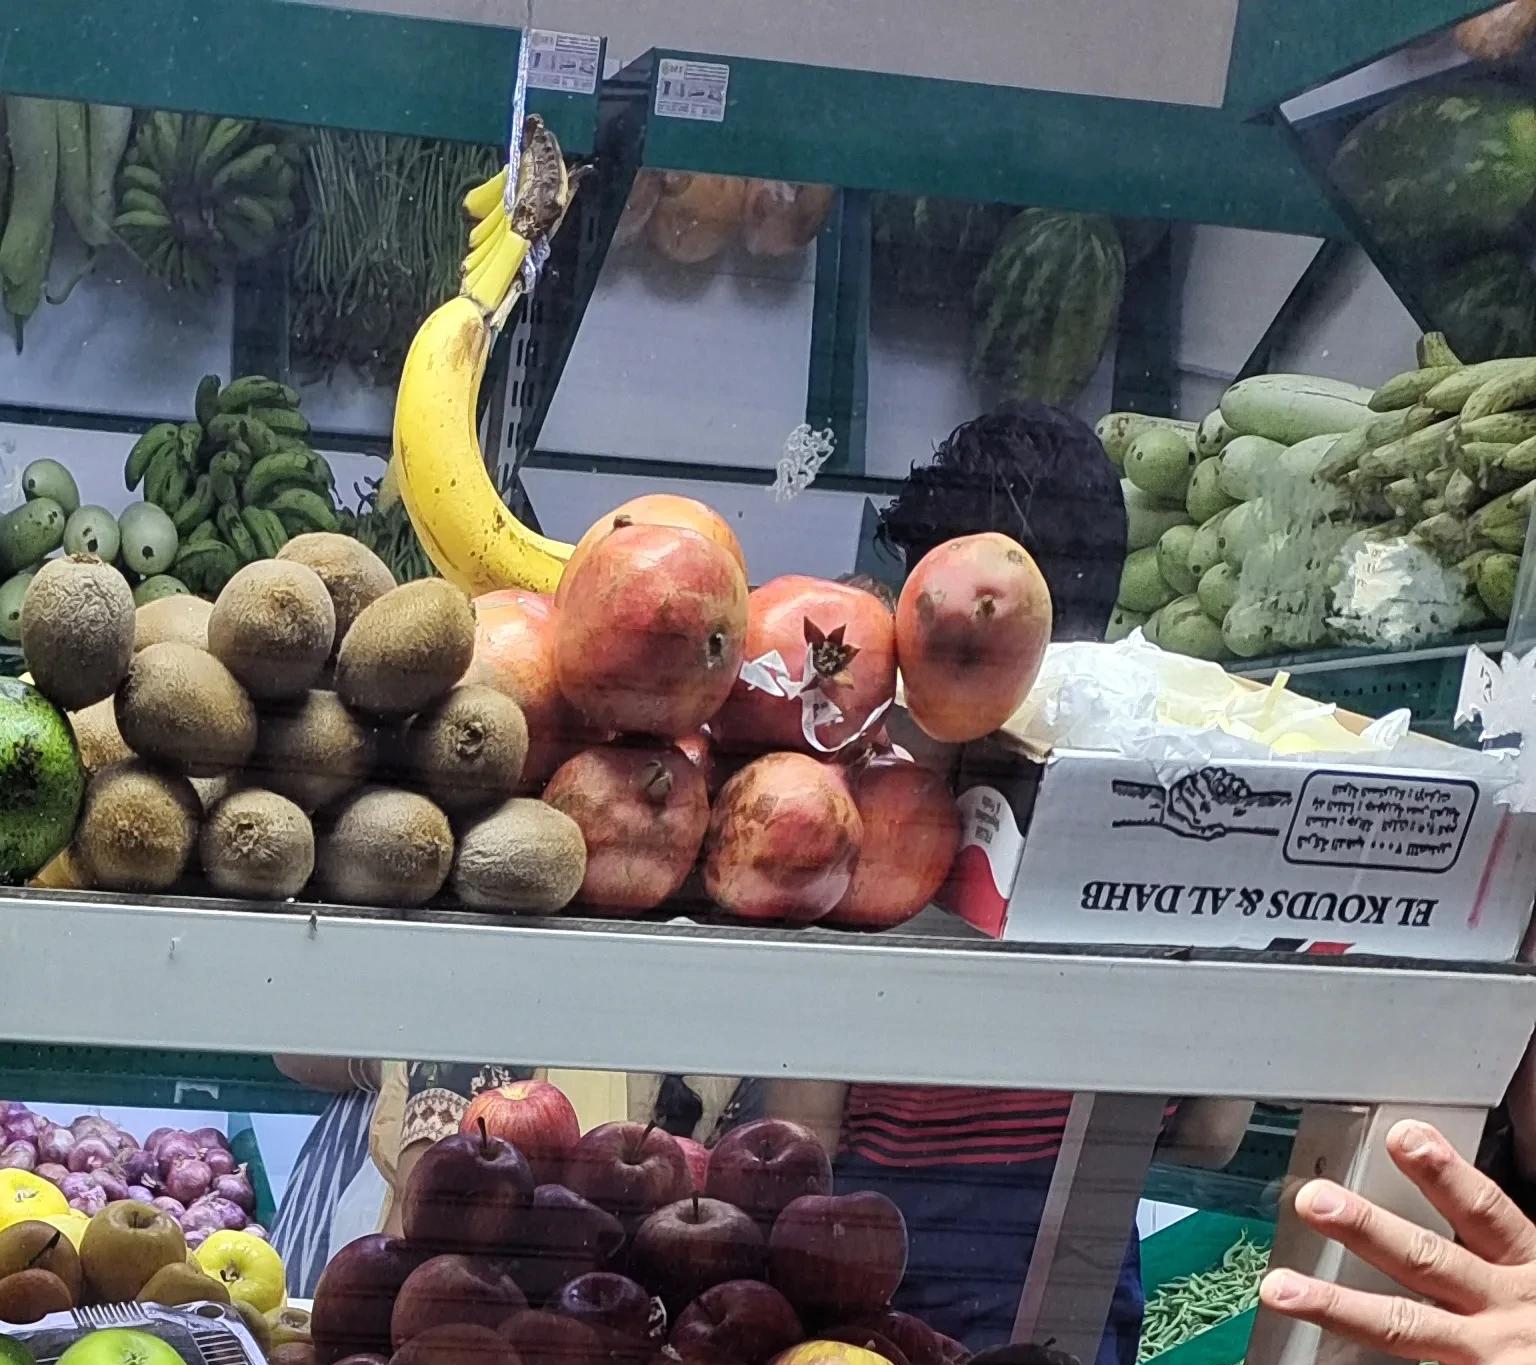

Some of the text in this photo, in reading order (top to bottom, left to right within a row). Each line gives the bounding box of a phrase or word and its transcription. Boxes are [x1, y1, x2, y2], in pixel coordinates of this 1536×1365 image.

[1080, 880, 1439, 927] EL KOUDS & AL DAHB
